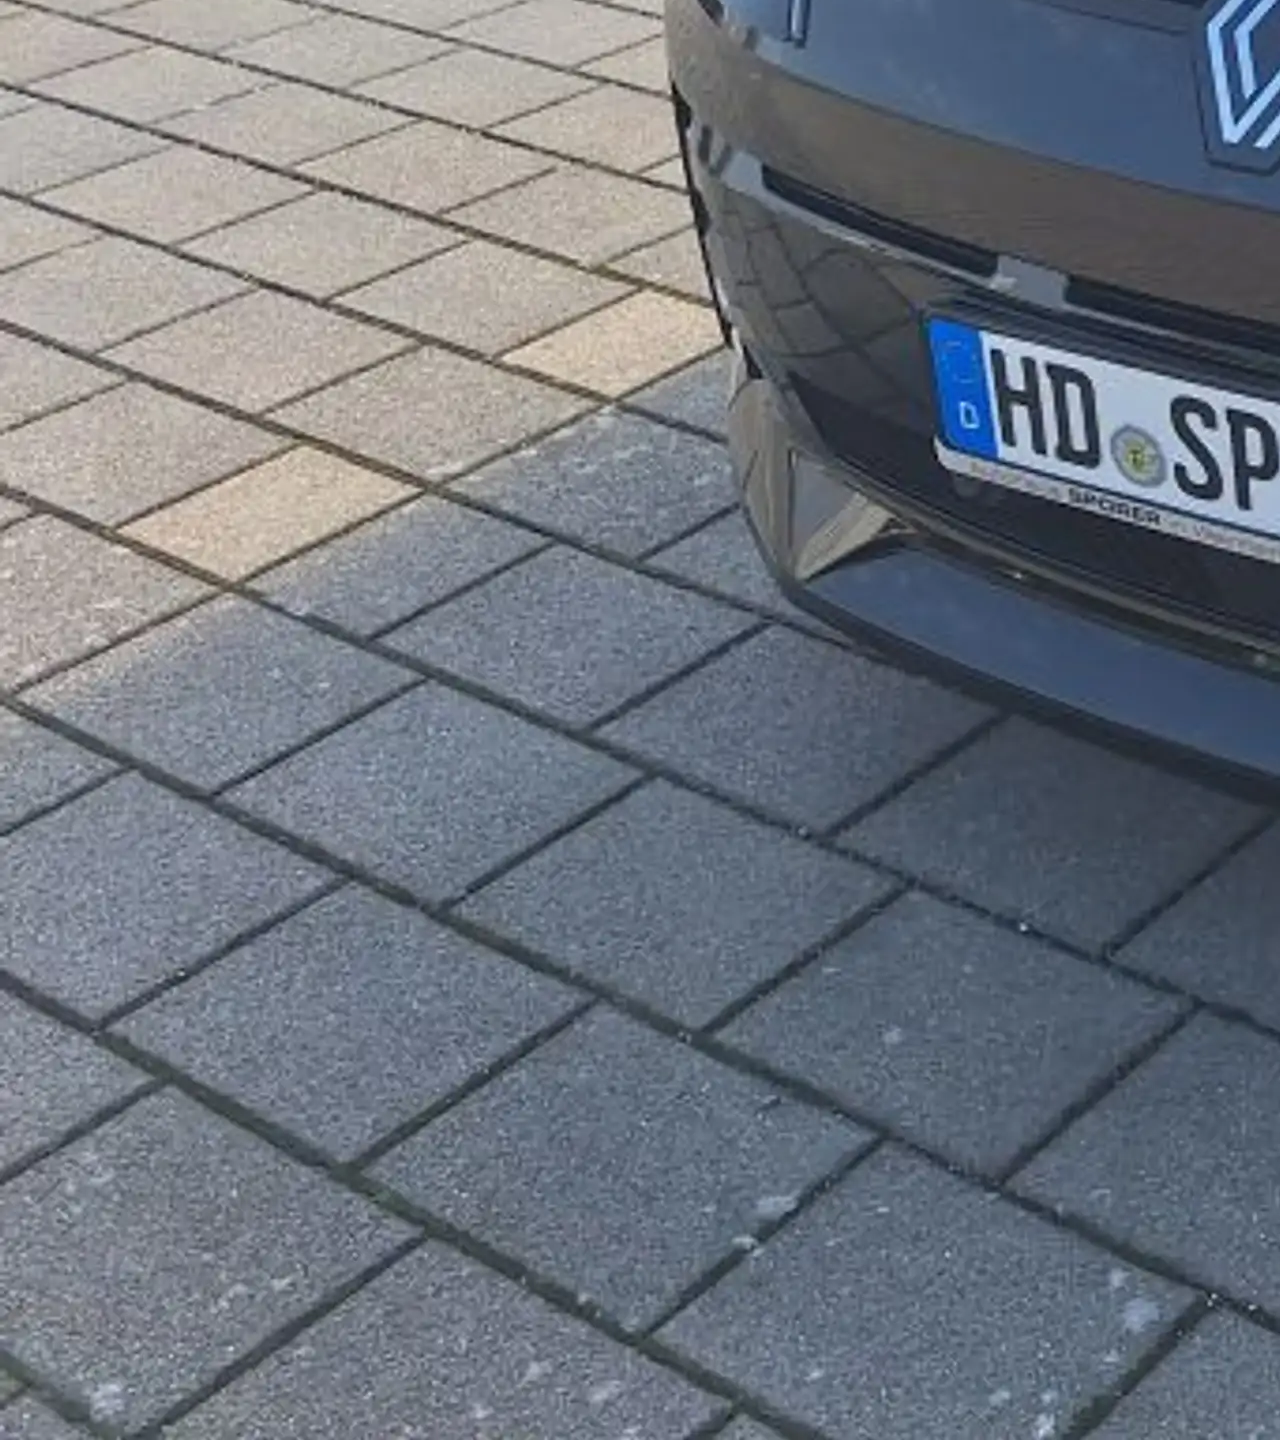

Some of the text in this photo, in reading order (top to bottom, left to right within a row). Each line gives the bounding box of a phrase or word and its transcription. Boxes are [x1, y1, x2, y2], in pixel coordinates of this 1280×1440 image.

[959, 401, 980, 429] D
[989, 348, 1101, 468] HD
[1169, 394, 1280, 511] SP
